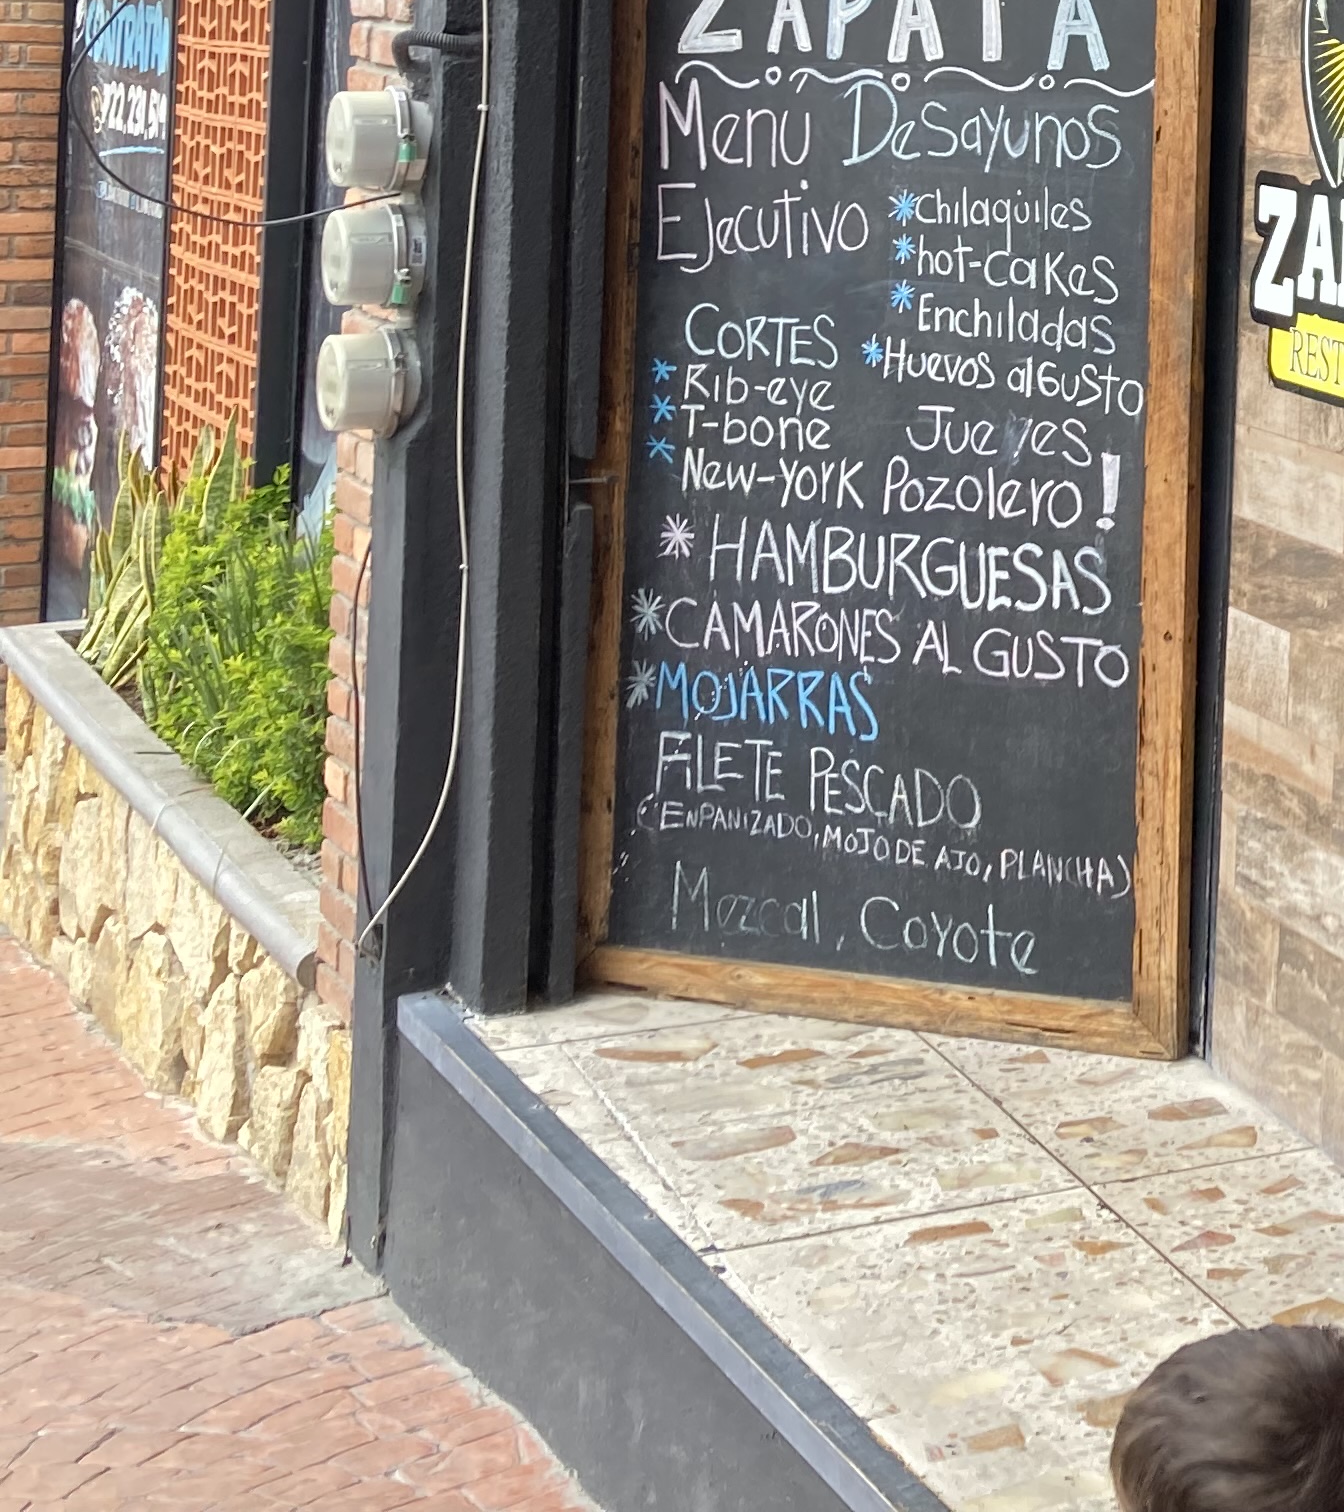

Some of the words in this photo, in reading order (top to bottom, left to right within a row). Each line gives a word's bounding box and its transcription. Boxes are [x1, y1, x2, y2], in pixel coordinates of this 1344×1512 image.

[841, 79, 1122, 173] Desayunos
[656, 180, 869, 273] Ejecutivo
[685, 303, 839, 369] CORTES
[883, 335, 996, 389] Huevos
[918, 292, 1116, 355] Enchiladas
[680, 404, 831, 453] T-bone
[684, 363, 835, 416] Rib-eye
[709, 513, 1112, 615] HAMBURGUESAS
[665, 593, 901, 664] CAMARONES
[912, 619, 962, 675] AL
[973, 628, 1130, 688] GUSTO
[655, 661, 879, 741] MOJARRAS
[656, 730, 786, 802] FILETE
[810, 746, 983, 829] PESCADO
[823, 824, 890, 862] MOJO
[896, 838, 927, 865] DE
[860, 896, 1039, 975] Coyote
